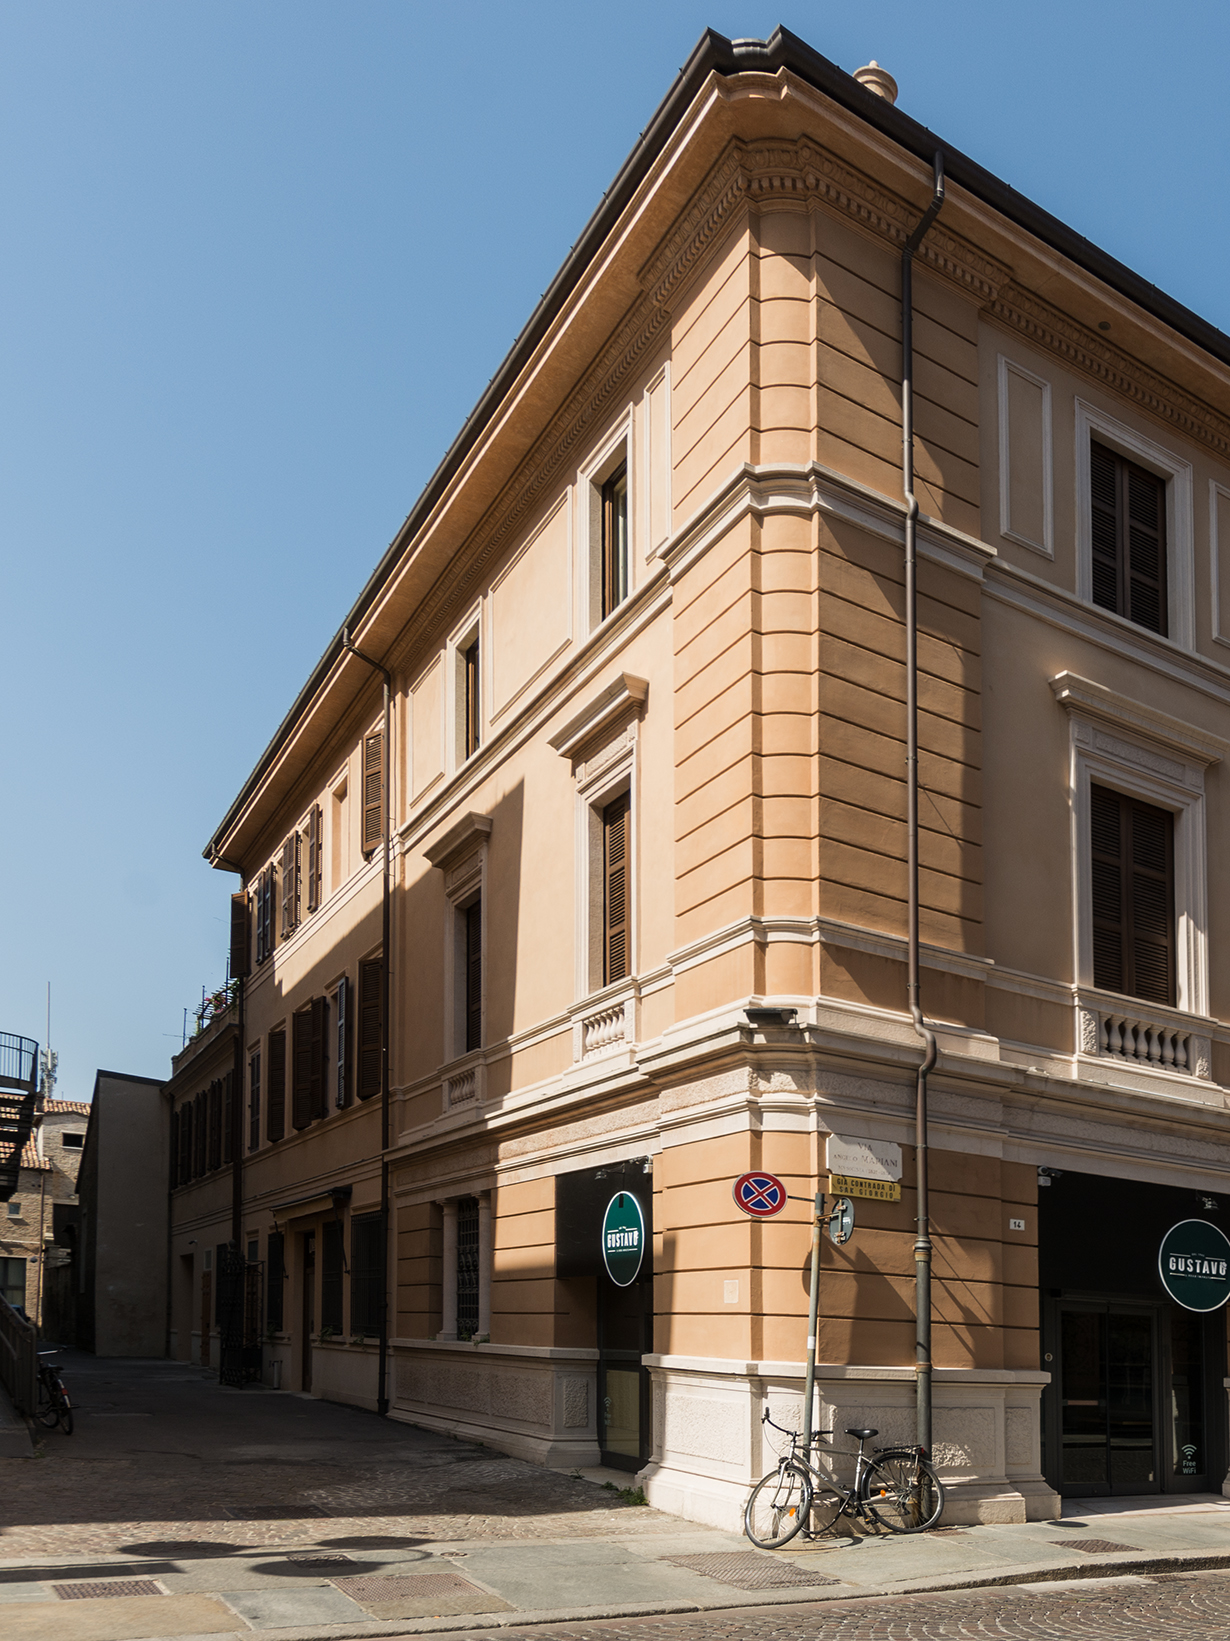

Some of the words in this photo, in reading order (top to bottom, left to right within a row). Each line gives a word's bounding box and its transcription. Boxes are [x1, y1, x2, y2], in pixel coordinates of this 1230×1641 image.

[857, 1142, 873, 1151] VIA
[861, 1155, 898, 1168] MARIANI
[851, 1180, 885, 1190] CONTRADA
[889, 1184, 896, 1192] DI
[859, 1188, 894, 1199] GIORGIO
[607, 1230, 639, 1248] GUSTAVO
[1169, 1257, 1227, 1276] GUSTAVO
